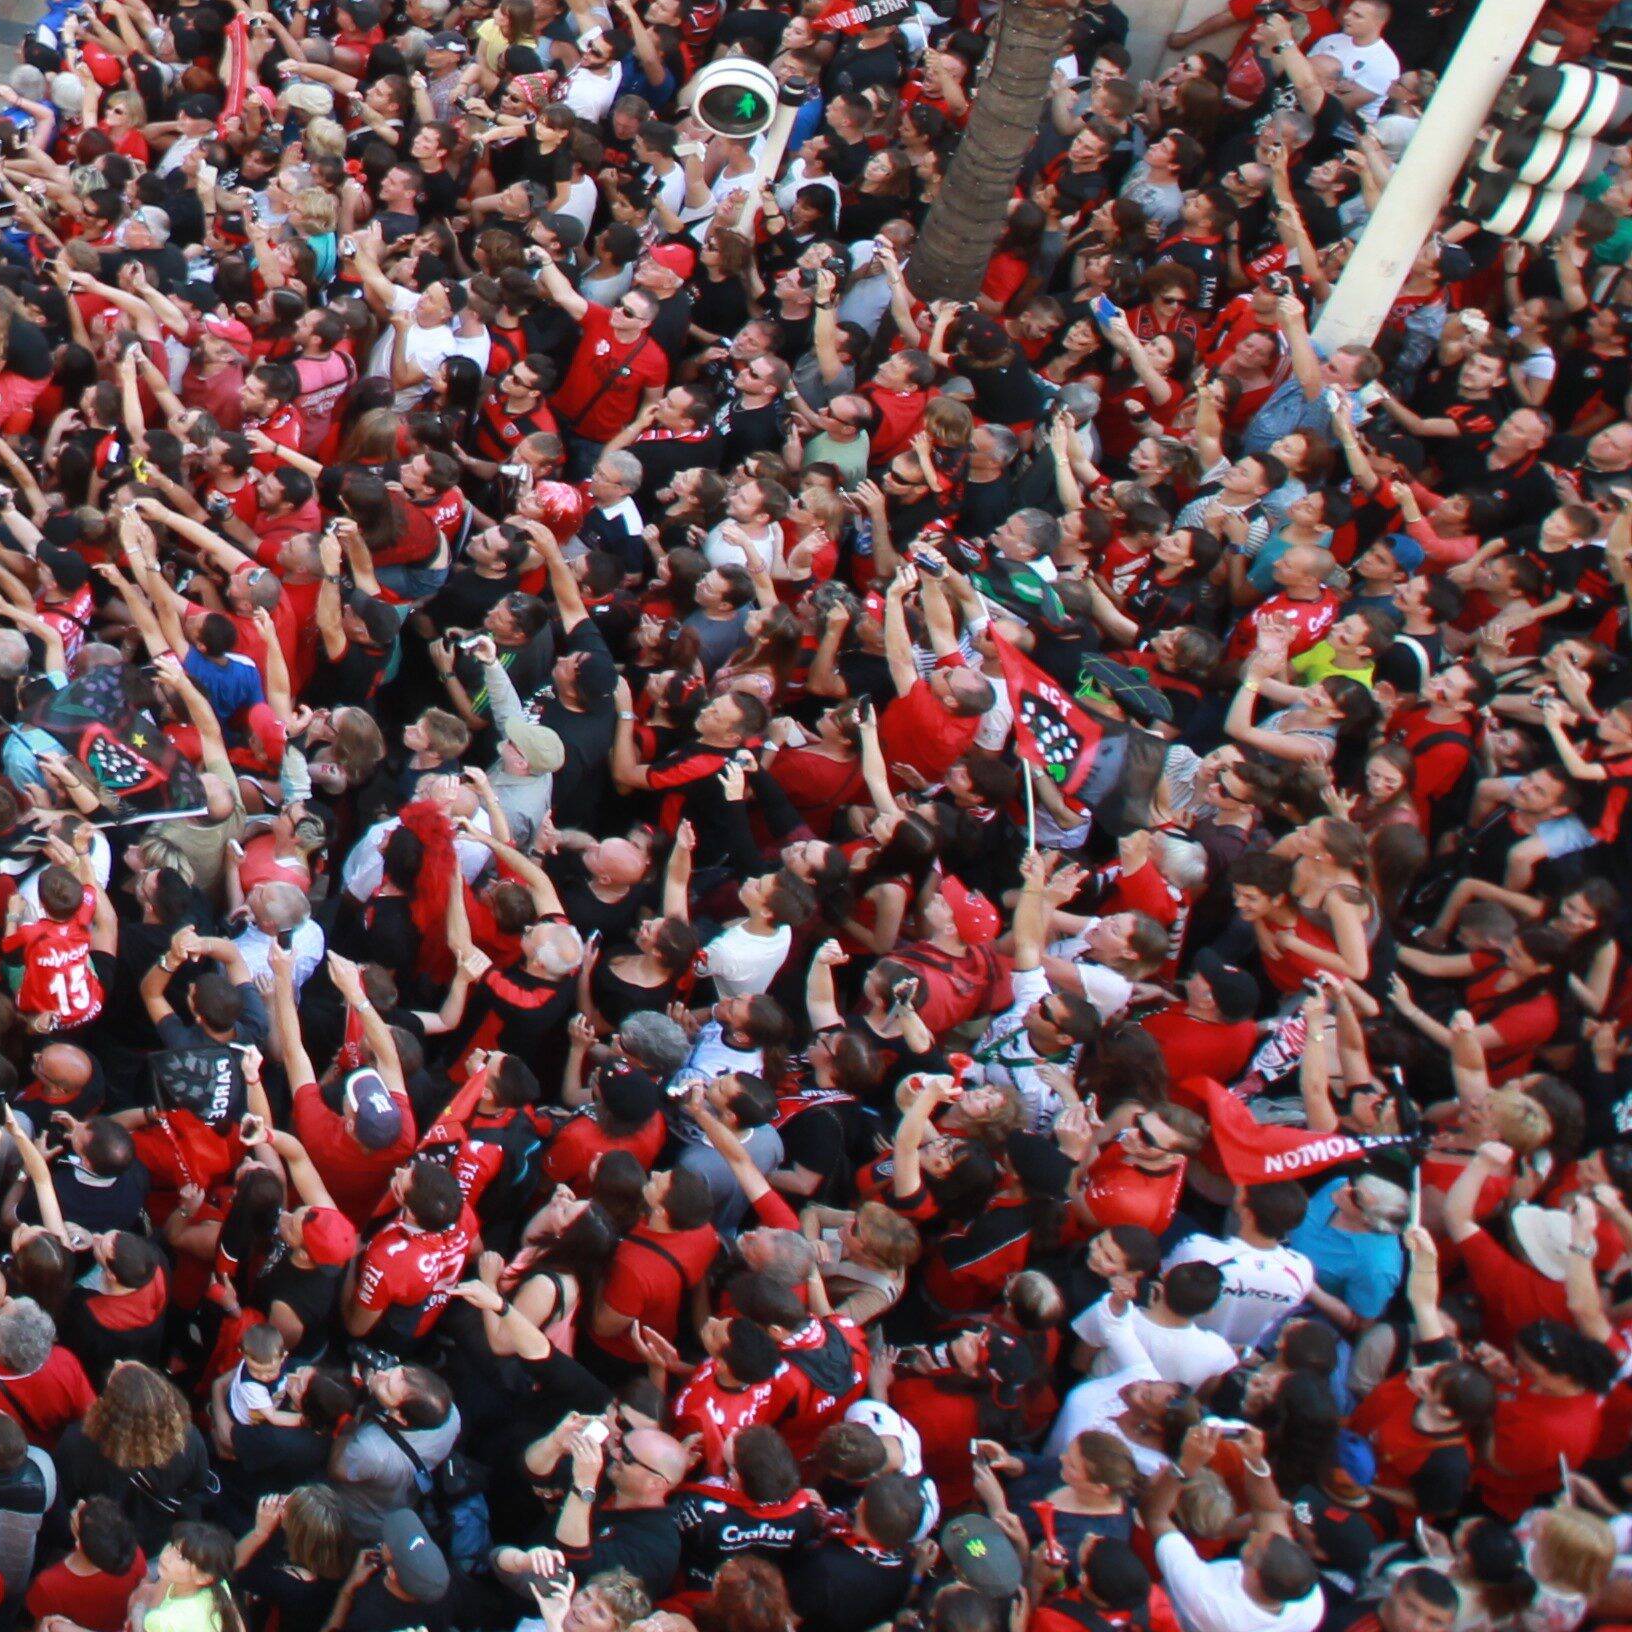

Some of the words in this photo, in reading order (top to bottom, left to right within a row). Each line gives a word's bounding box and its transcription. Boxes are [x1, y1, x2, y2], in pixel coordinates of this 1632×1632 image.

[1038, 681, 1072, 717] RCT
[48, 965, 91, 1017] 15
[720, 1521, 796, 1545] Crafter
